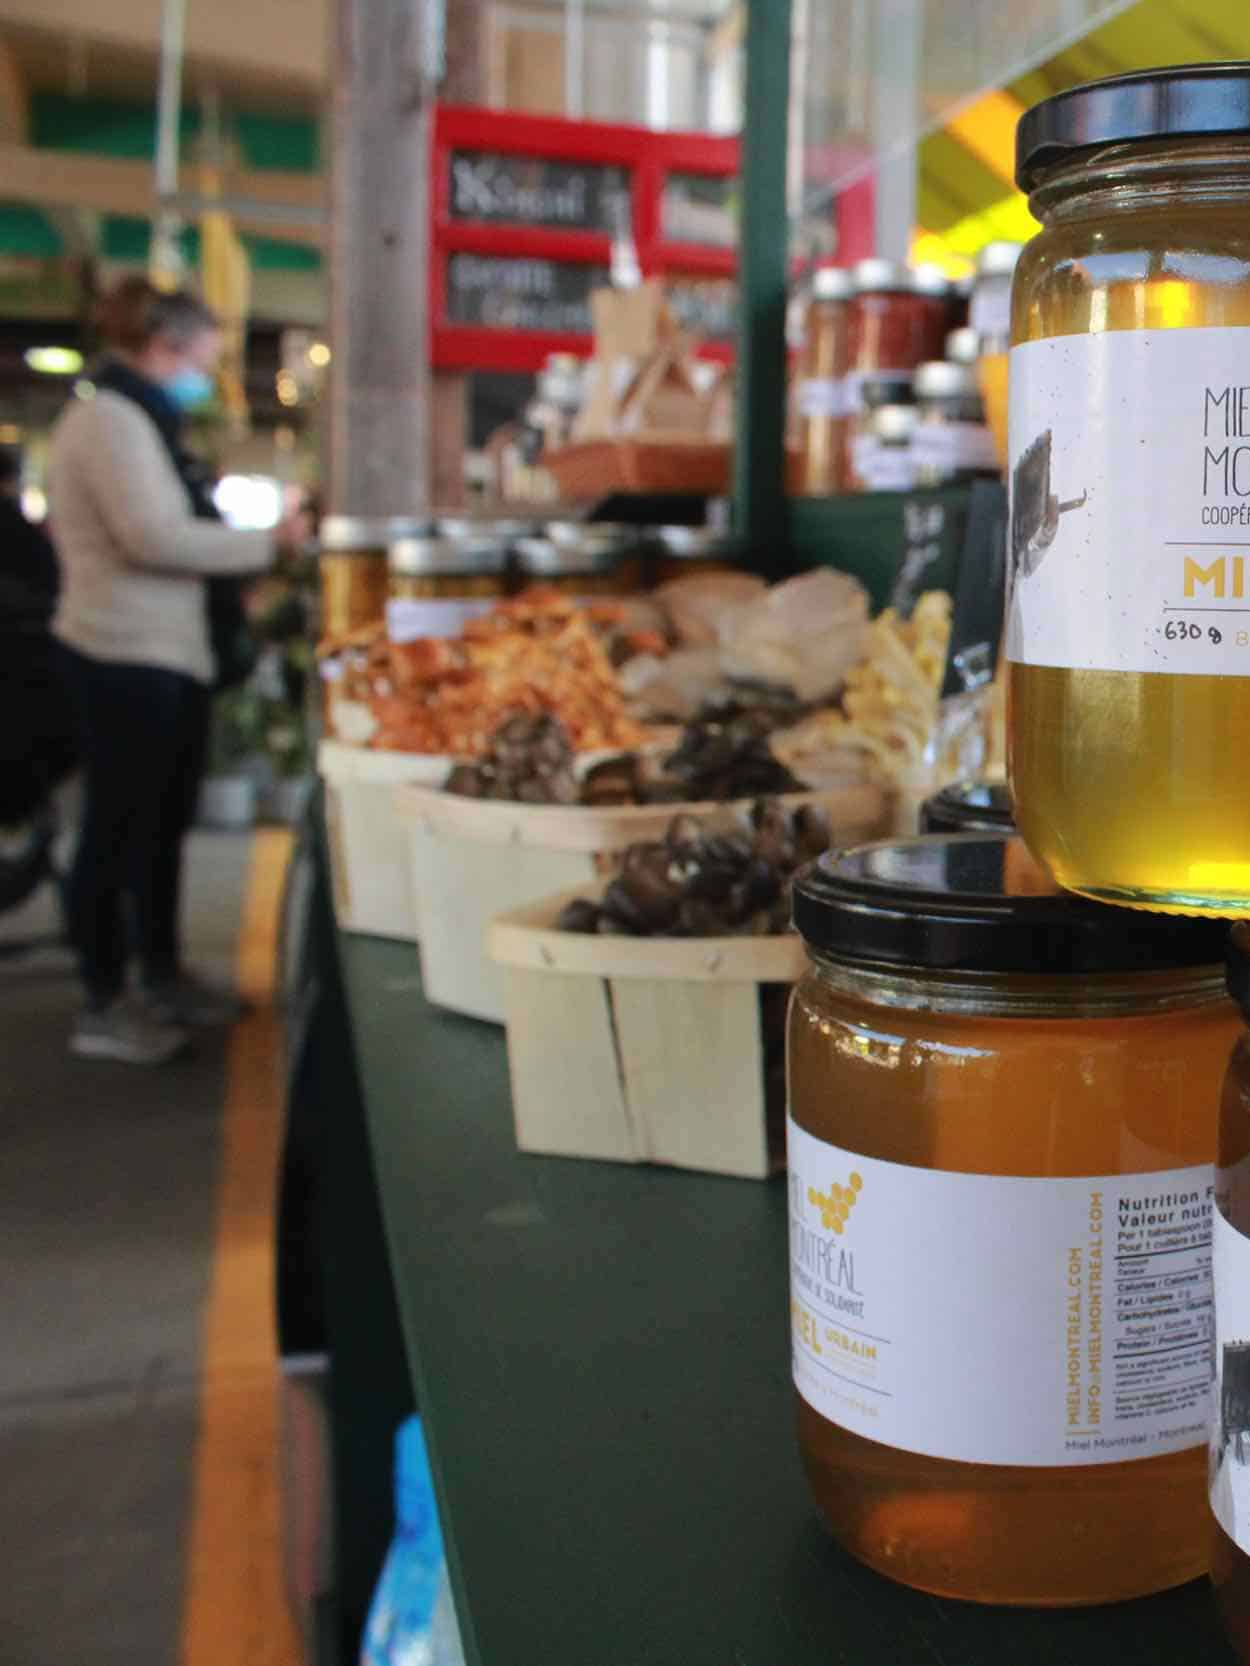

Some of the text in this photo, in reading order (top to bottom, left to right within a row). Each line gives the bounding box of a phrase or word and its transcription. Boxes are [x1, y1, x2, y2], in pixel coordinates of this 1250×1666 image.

[1164, 620, 1202, 640] 630
[1118, 1192, 1199, 1211] Nutrition
[1118, 1211, 1175, 1227] Valeur
[1067, 1247, 1082, 1425] MIELMONTREAL.COM
